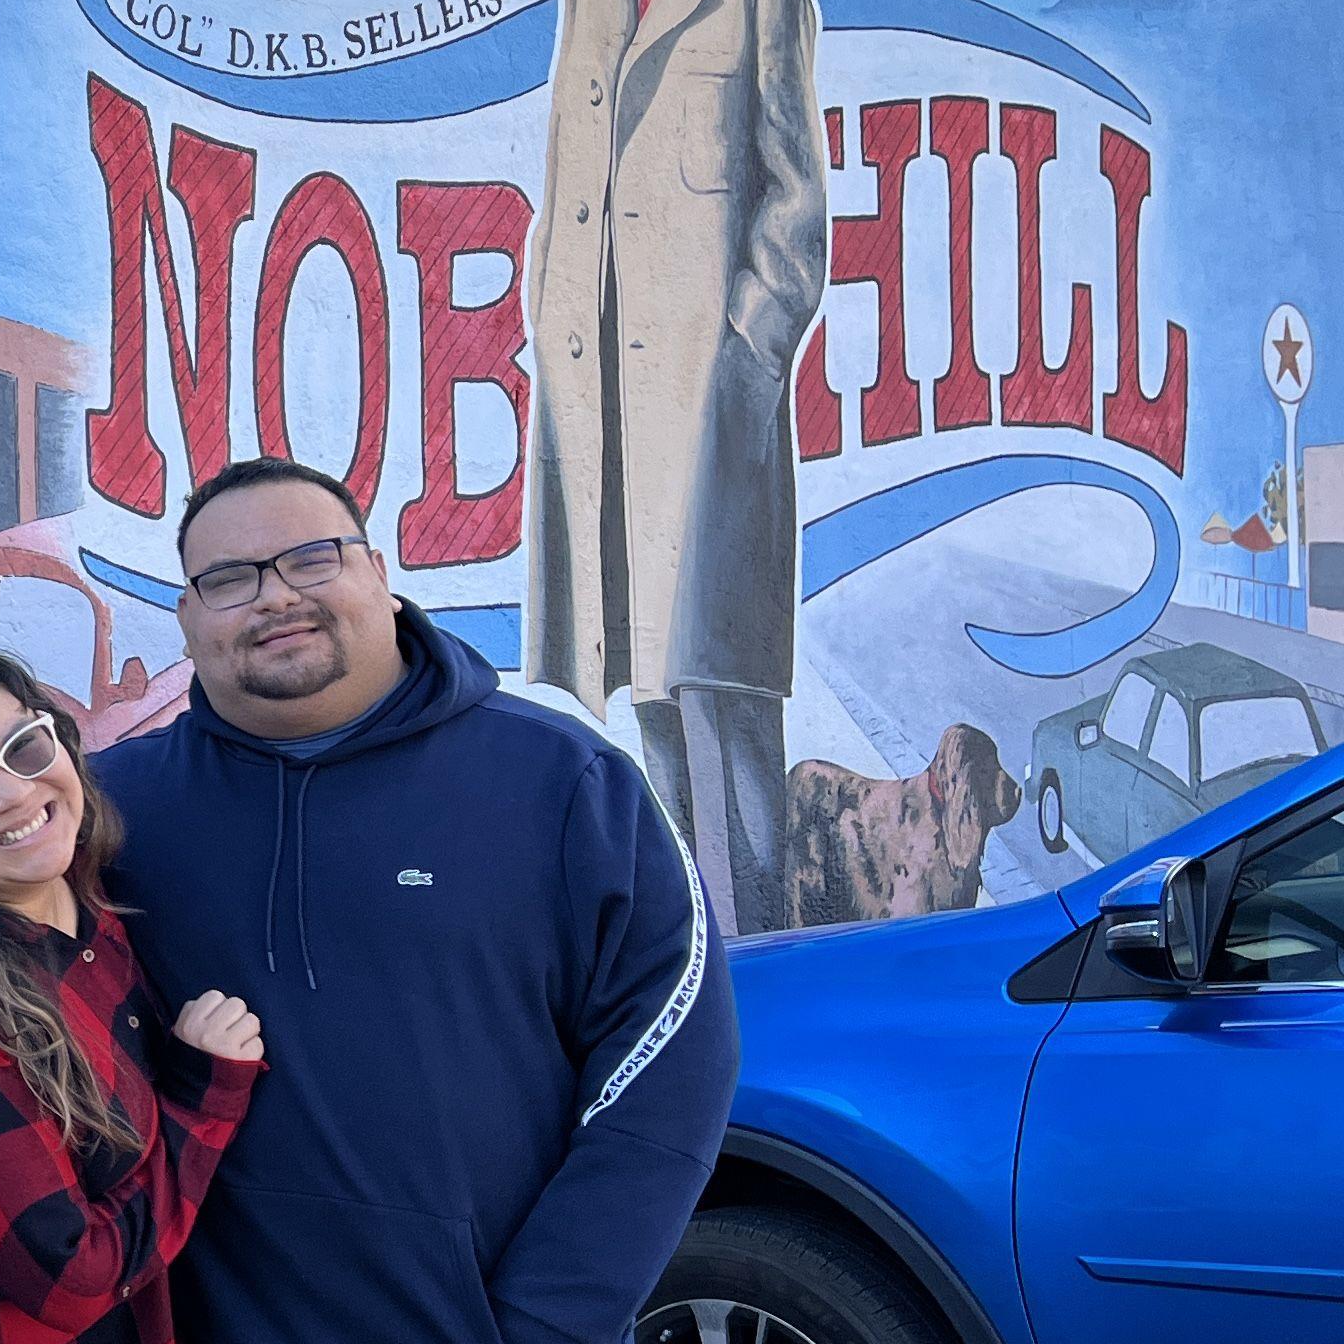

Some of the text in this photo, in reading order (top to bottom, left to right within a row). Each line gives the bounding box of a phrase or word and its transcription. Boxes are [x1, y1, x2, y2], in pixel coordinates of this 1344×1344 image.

[227, 27, 336, 72] D.K.B.
[86, 70, 1188, 568] NOB HILL
